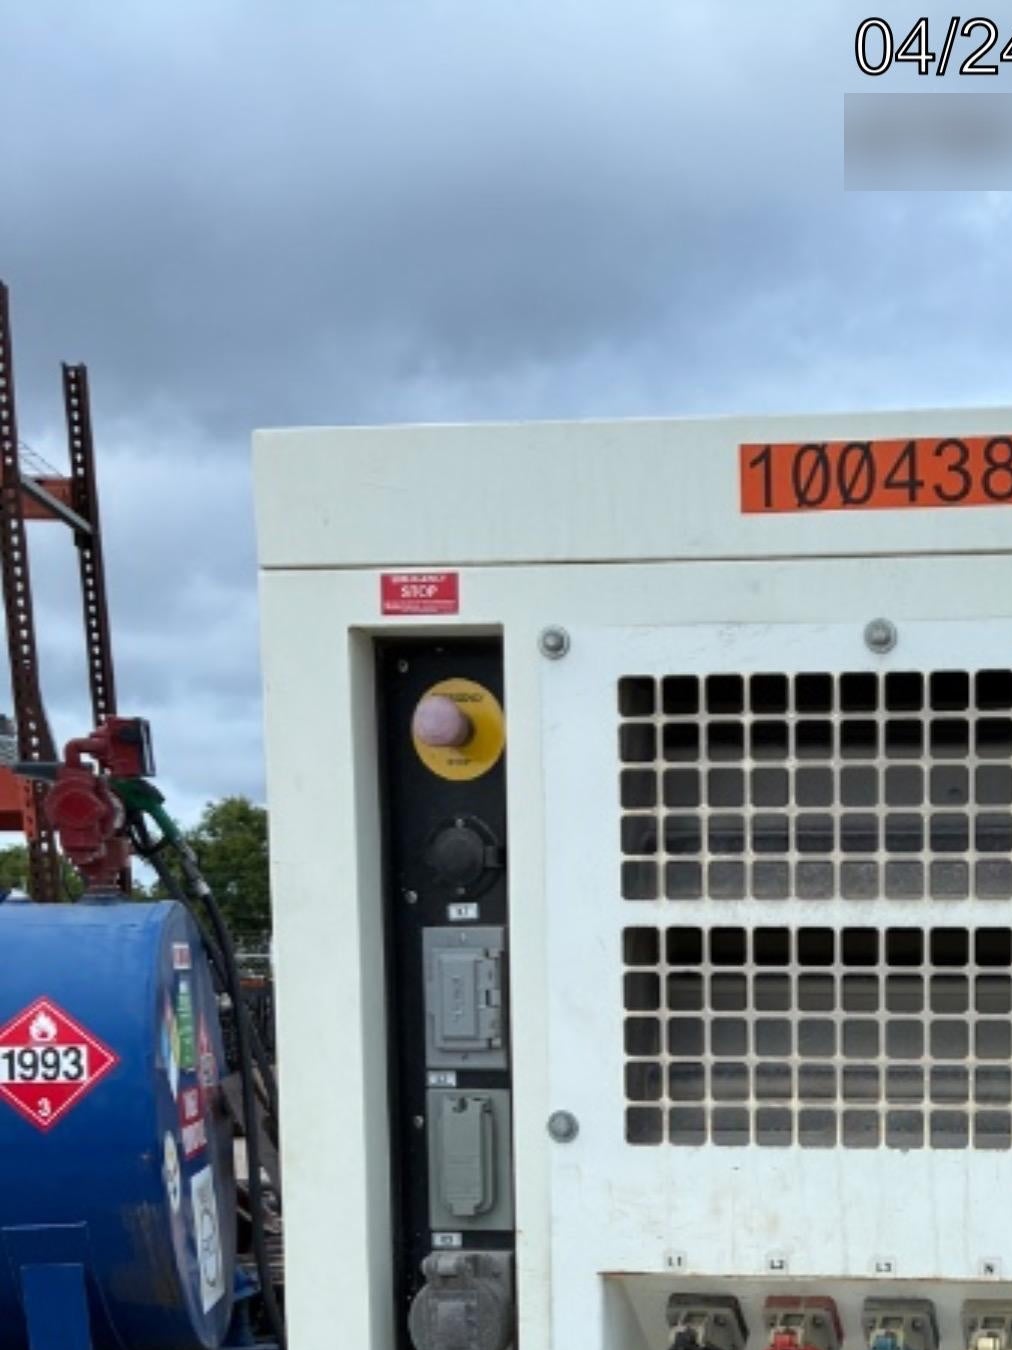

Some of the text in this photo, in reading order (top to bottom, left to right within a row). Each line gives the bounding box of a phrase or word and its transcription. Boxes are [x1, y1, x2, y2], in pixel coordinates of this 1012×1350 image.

[400, 584, 439, 599] STOP
[2, 1046, 84, 1081] 1993
[37, 1096, 52, 1117] 3
[769, 1259, 785, 1271] L2
[875, 1262, 893, 1273] L3
[983, 1263, 995, 1274] N
